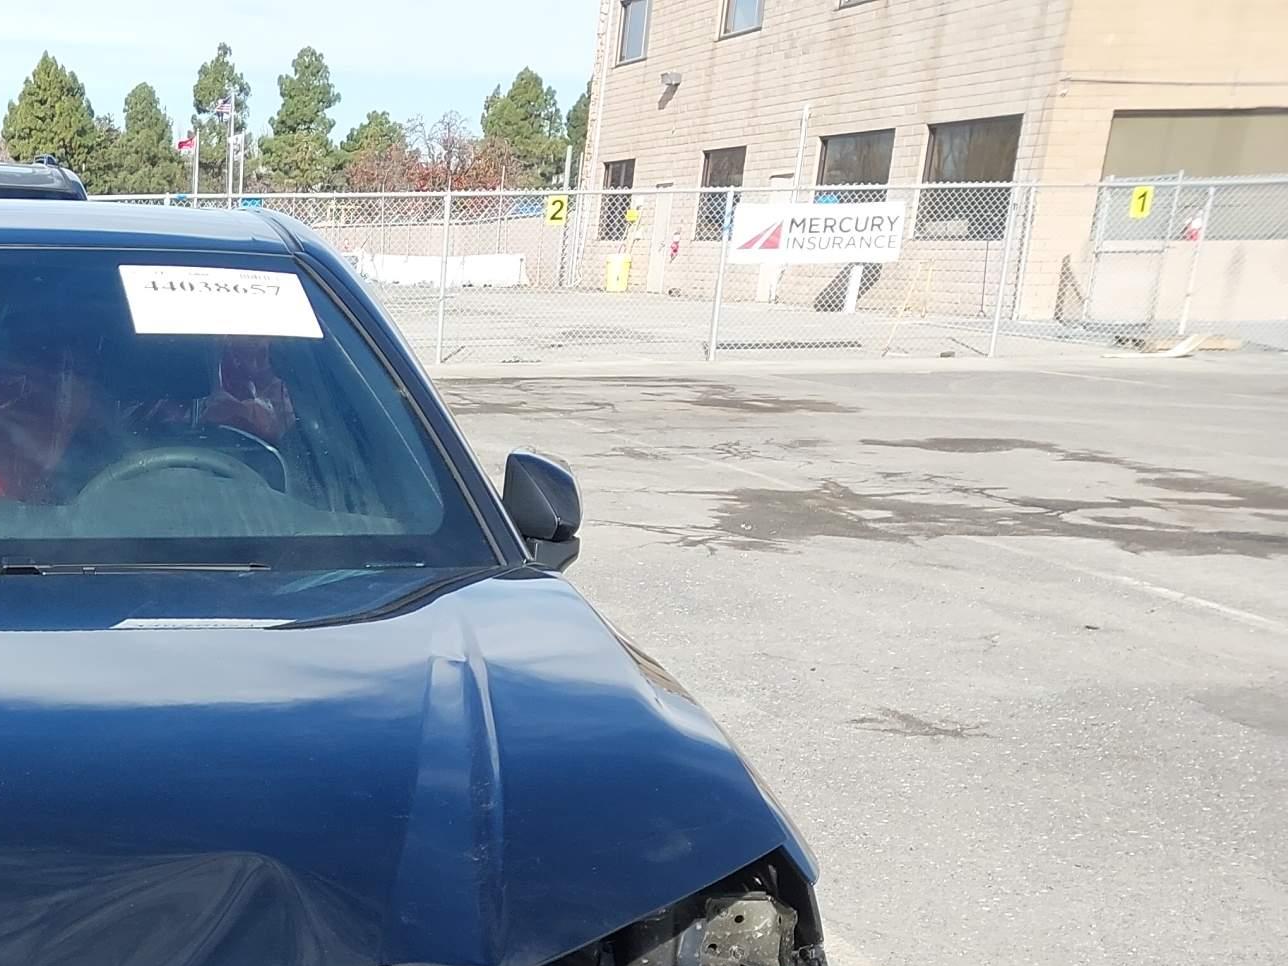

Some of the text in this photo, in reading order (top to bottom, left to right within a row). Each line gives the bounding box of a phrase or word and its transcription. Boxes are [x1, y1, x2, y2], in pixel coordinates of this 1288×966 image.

[550, 199, 564, 220] 2
[1138, 190, 1148, 212] 1
[789, 215, 900, 234] MERCURY
[786, 234, 897, 250] INSURANCE
[144, 279, 281, 297] 44038657
